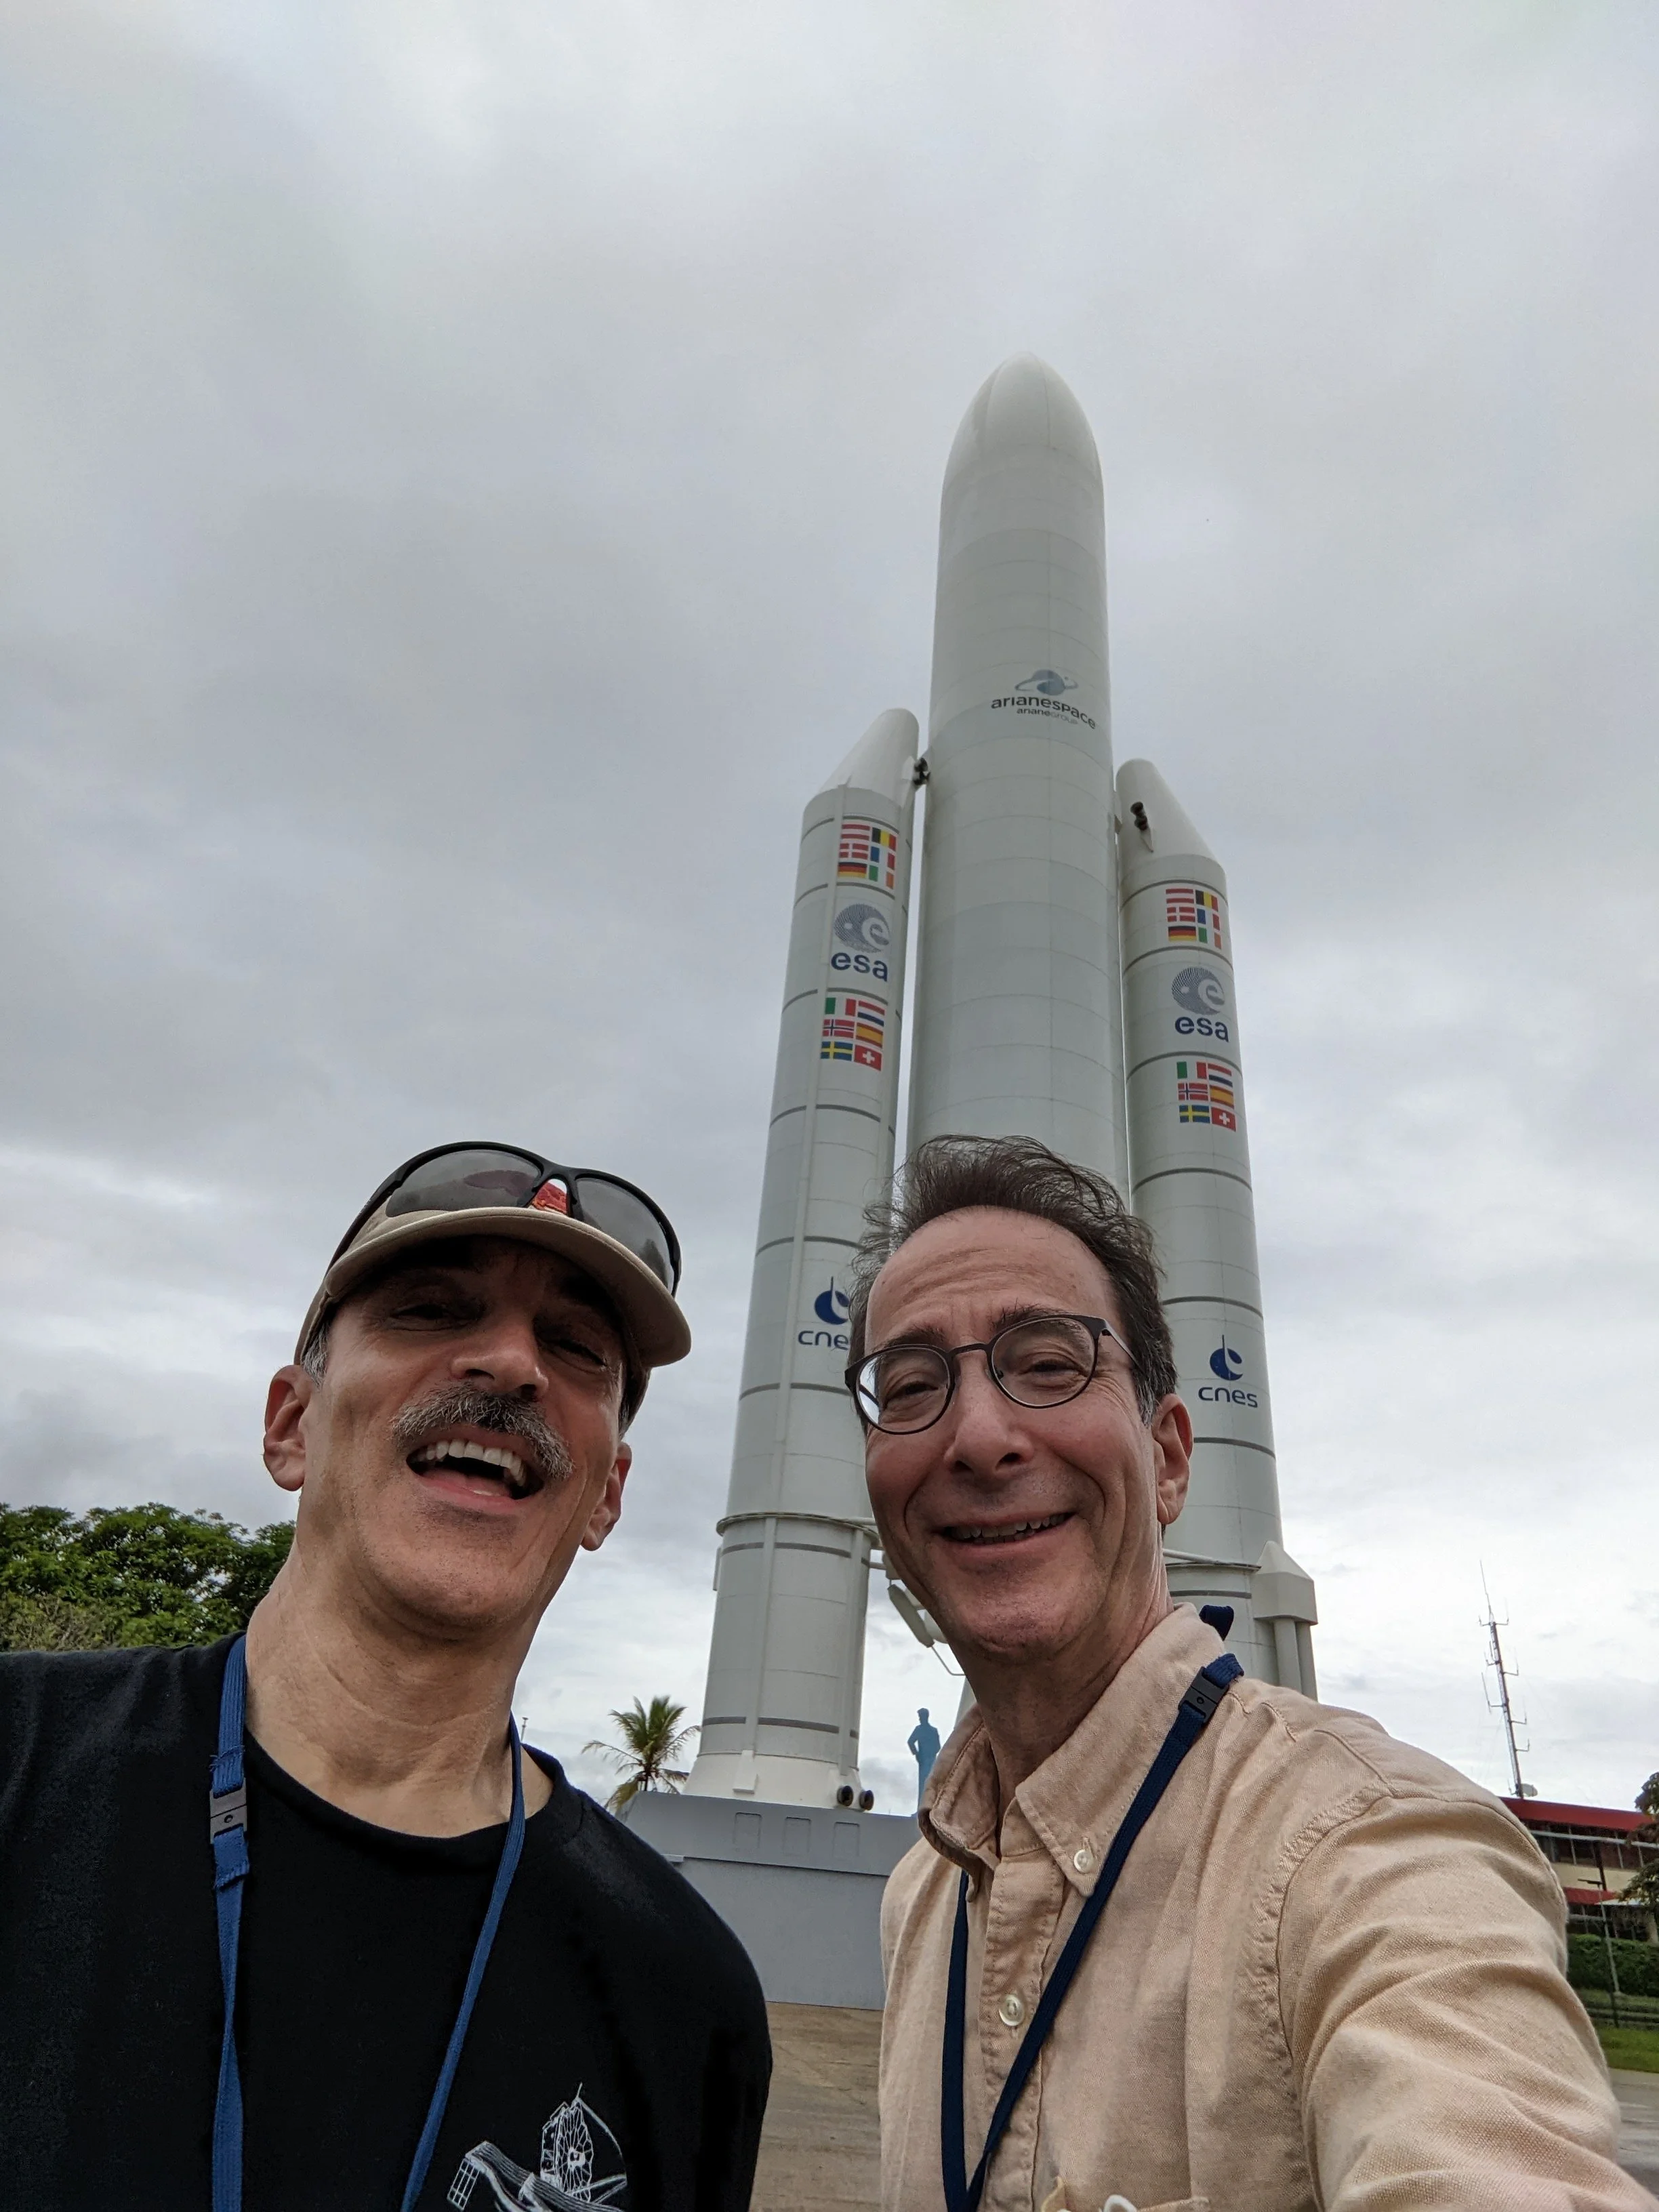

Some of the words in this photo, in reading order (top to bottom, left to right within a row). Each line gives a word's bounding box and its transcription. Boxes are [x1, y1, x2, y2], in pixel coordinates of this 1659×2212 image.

[991, 696, 1096, 730] arianespace
[831, 952, 888, 982] esa
[1174, 1017, 1229, 1042] esa
[798, 1330, 848, 1351] cne
[1198, 1387, 1258, 1408] cnes
